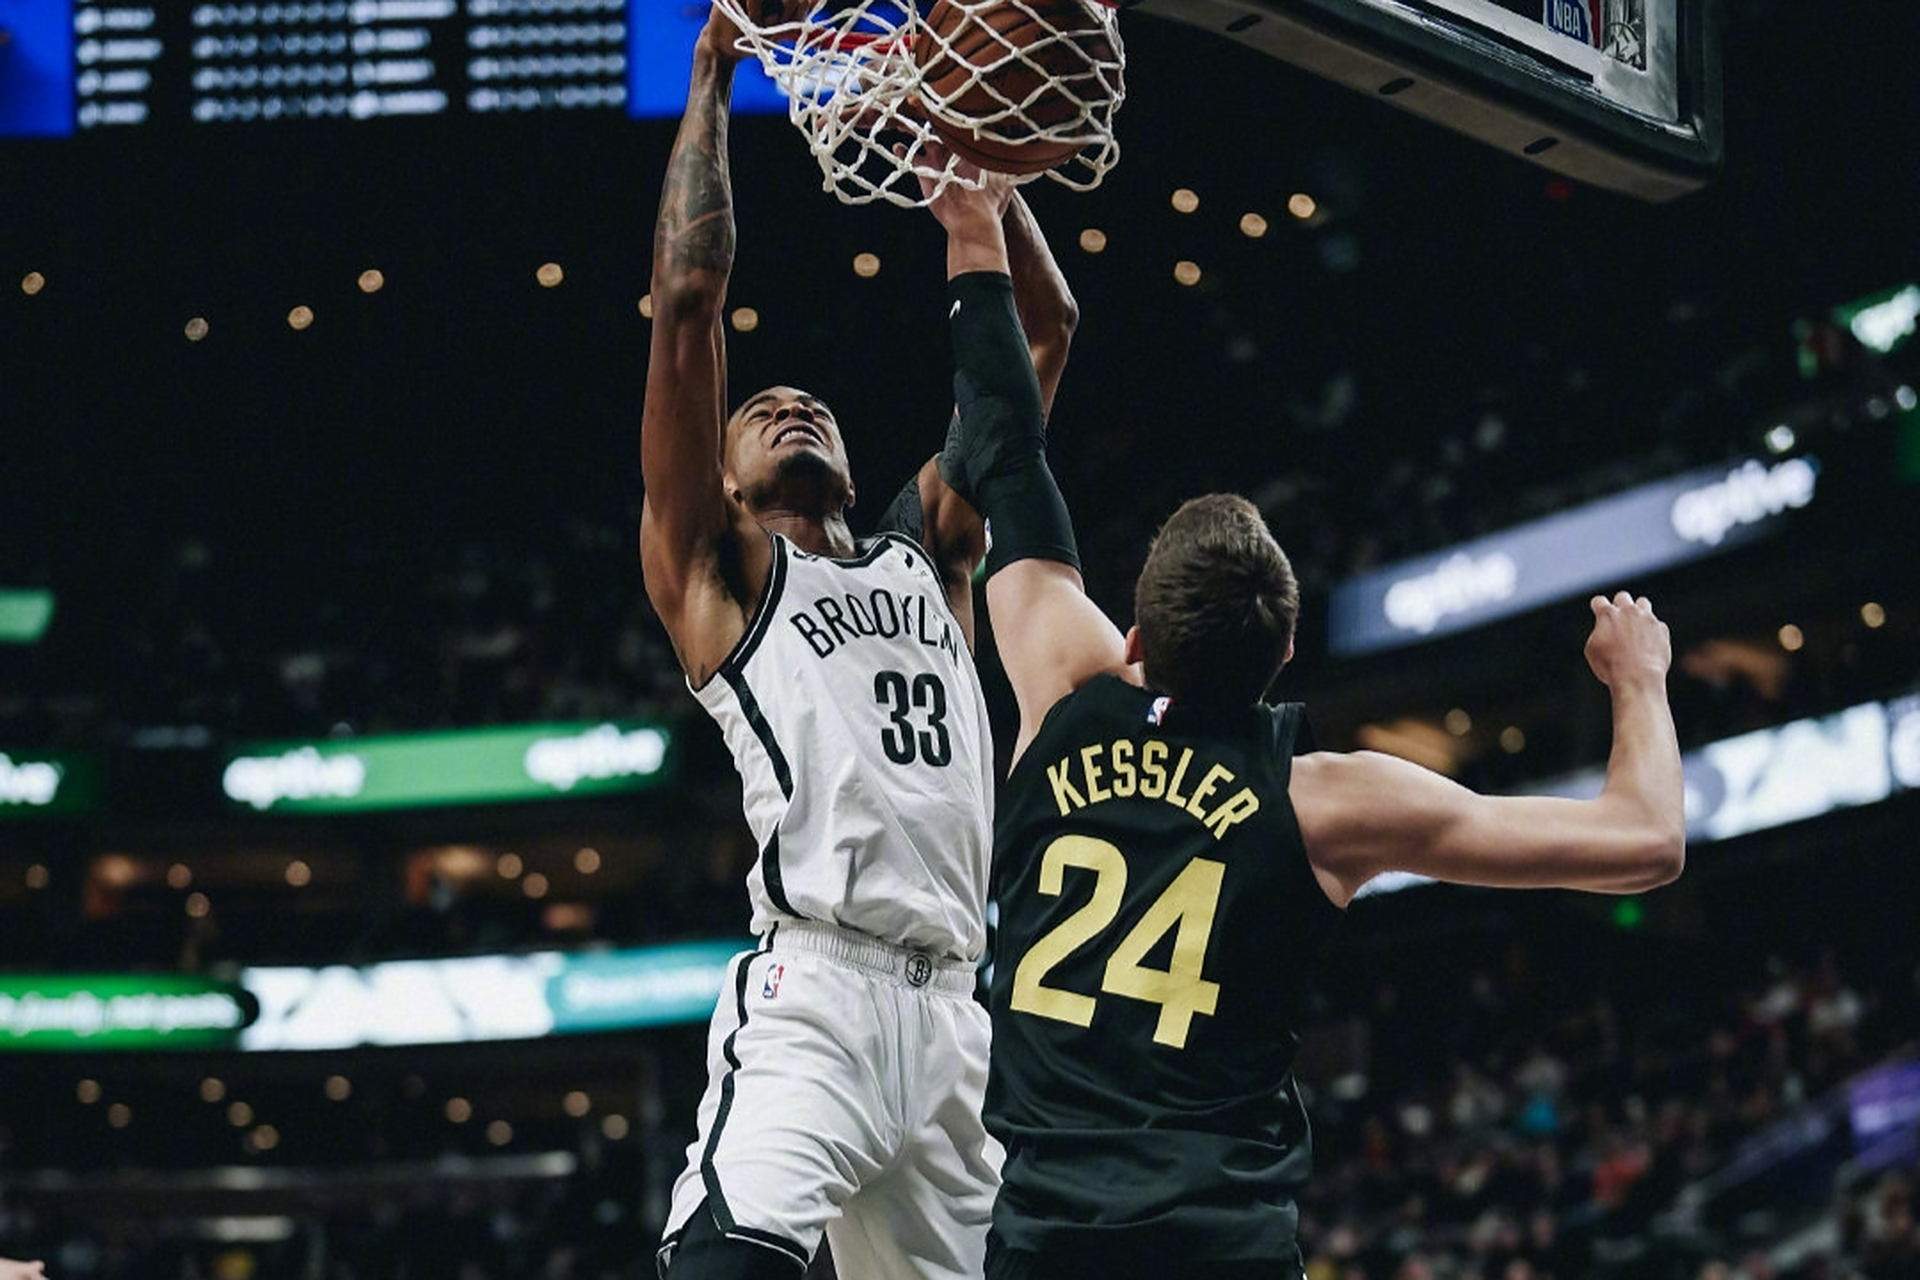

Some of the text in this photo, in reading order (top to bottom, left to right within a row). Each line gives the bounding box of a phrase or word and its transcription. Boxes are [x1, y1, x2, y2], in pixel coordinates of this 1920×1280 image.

[1553, 0, 1581, 38] NBA
[874, 670, 952, 767] 33
[1046, 739, 1260, 840] KESSLER
[1010, 834, 1226, 1050] 24
